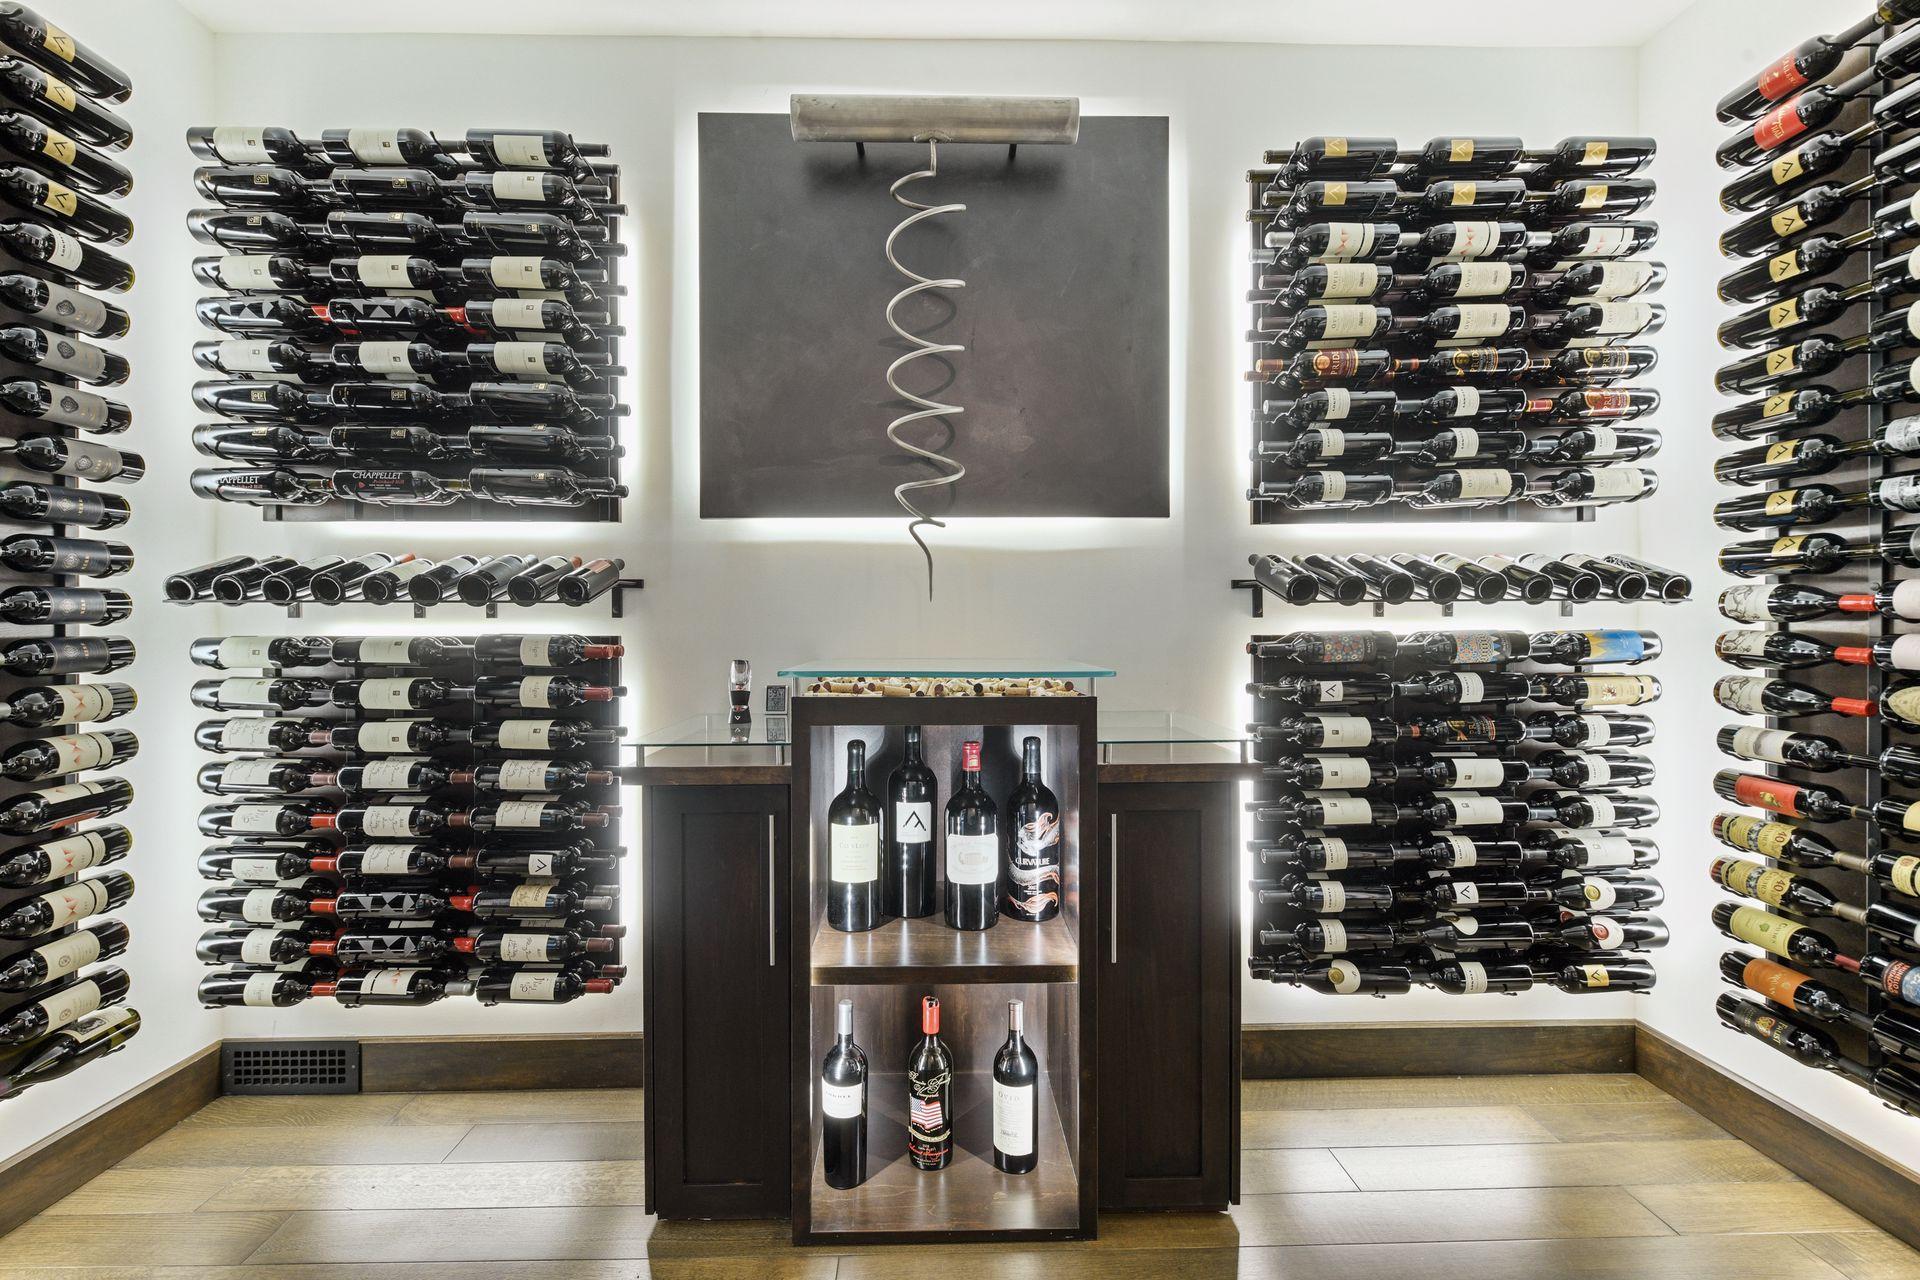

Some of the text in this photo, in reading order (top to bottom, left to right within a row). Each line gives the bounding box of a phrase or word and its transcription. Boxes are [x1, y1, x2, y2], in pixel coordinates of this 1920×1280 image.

[352, 471, 403, 480] CHAPPELLET
[1773, 879, 1786, 892] 40
[1772, 1021, 1788, 1044] FAUST
